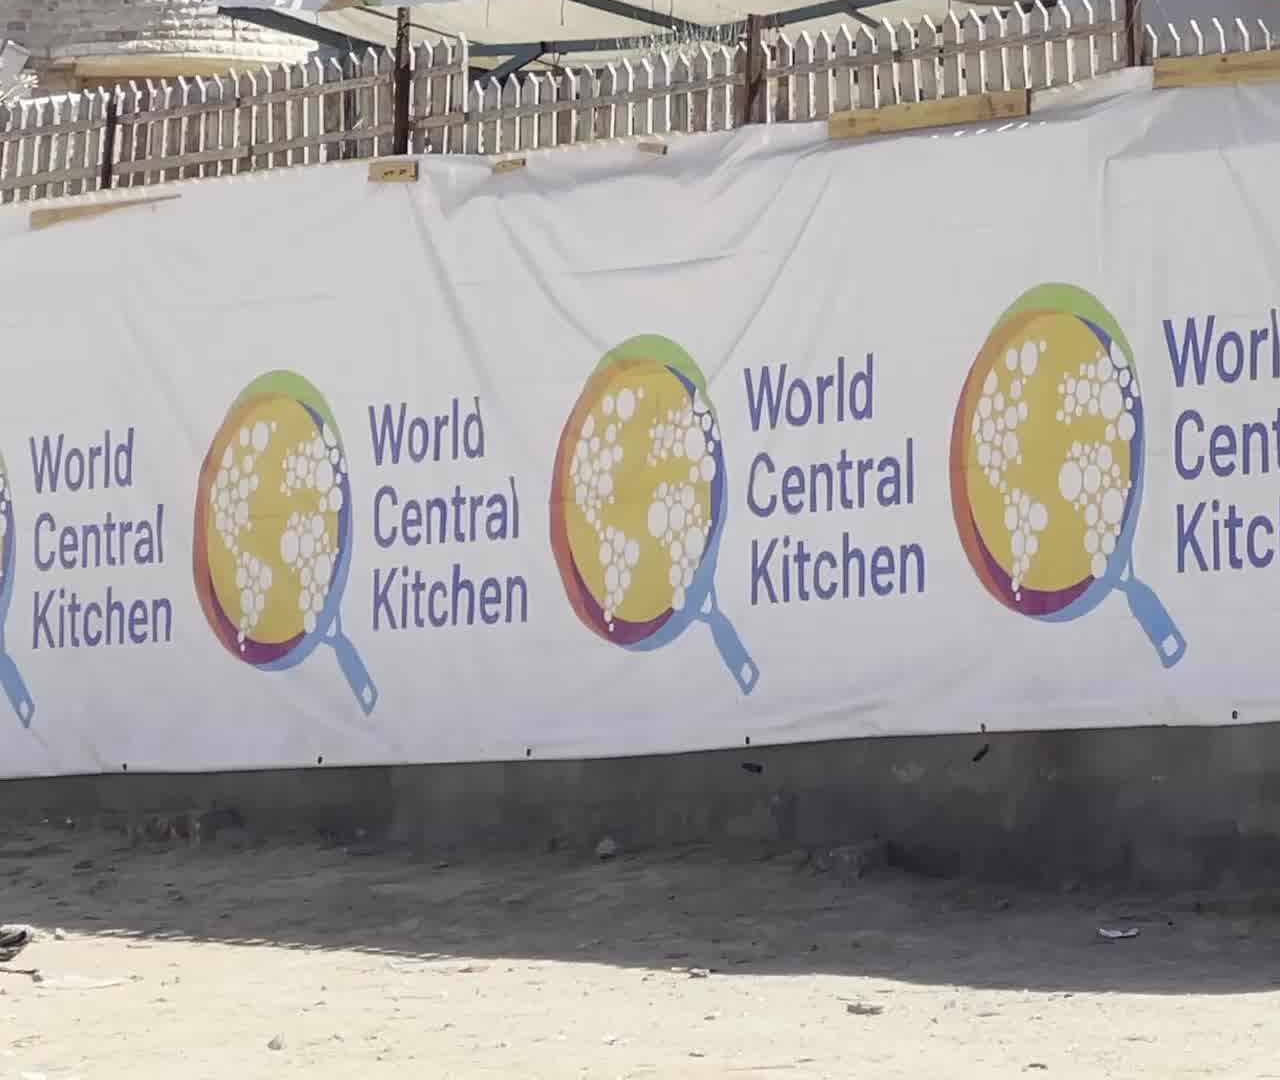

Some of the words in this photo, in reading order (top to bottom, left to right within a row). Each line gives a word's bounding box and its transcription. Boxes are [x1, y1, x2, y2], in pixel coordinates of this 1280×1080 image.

[744, 352, 874, 432] World
[29, 427, 135, 494] World
[368, 396, 485, 466] World
[373, 476, 520, 548] Central
[747, 437, 914, 518] Central
[33, 503, 164, 571] Central
[751, 532, 925, 605] Kitchen
[32, 586, 172, 650] Kitchen
[372, 563, 528, 631] Kitchen
